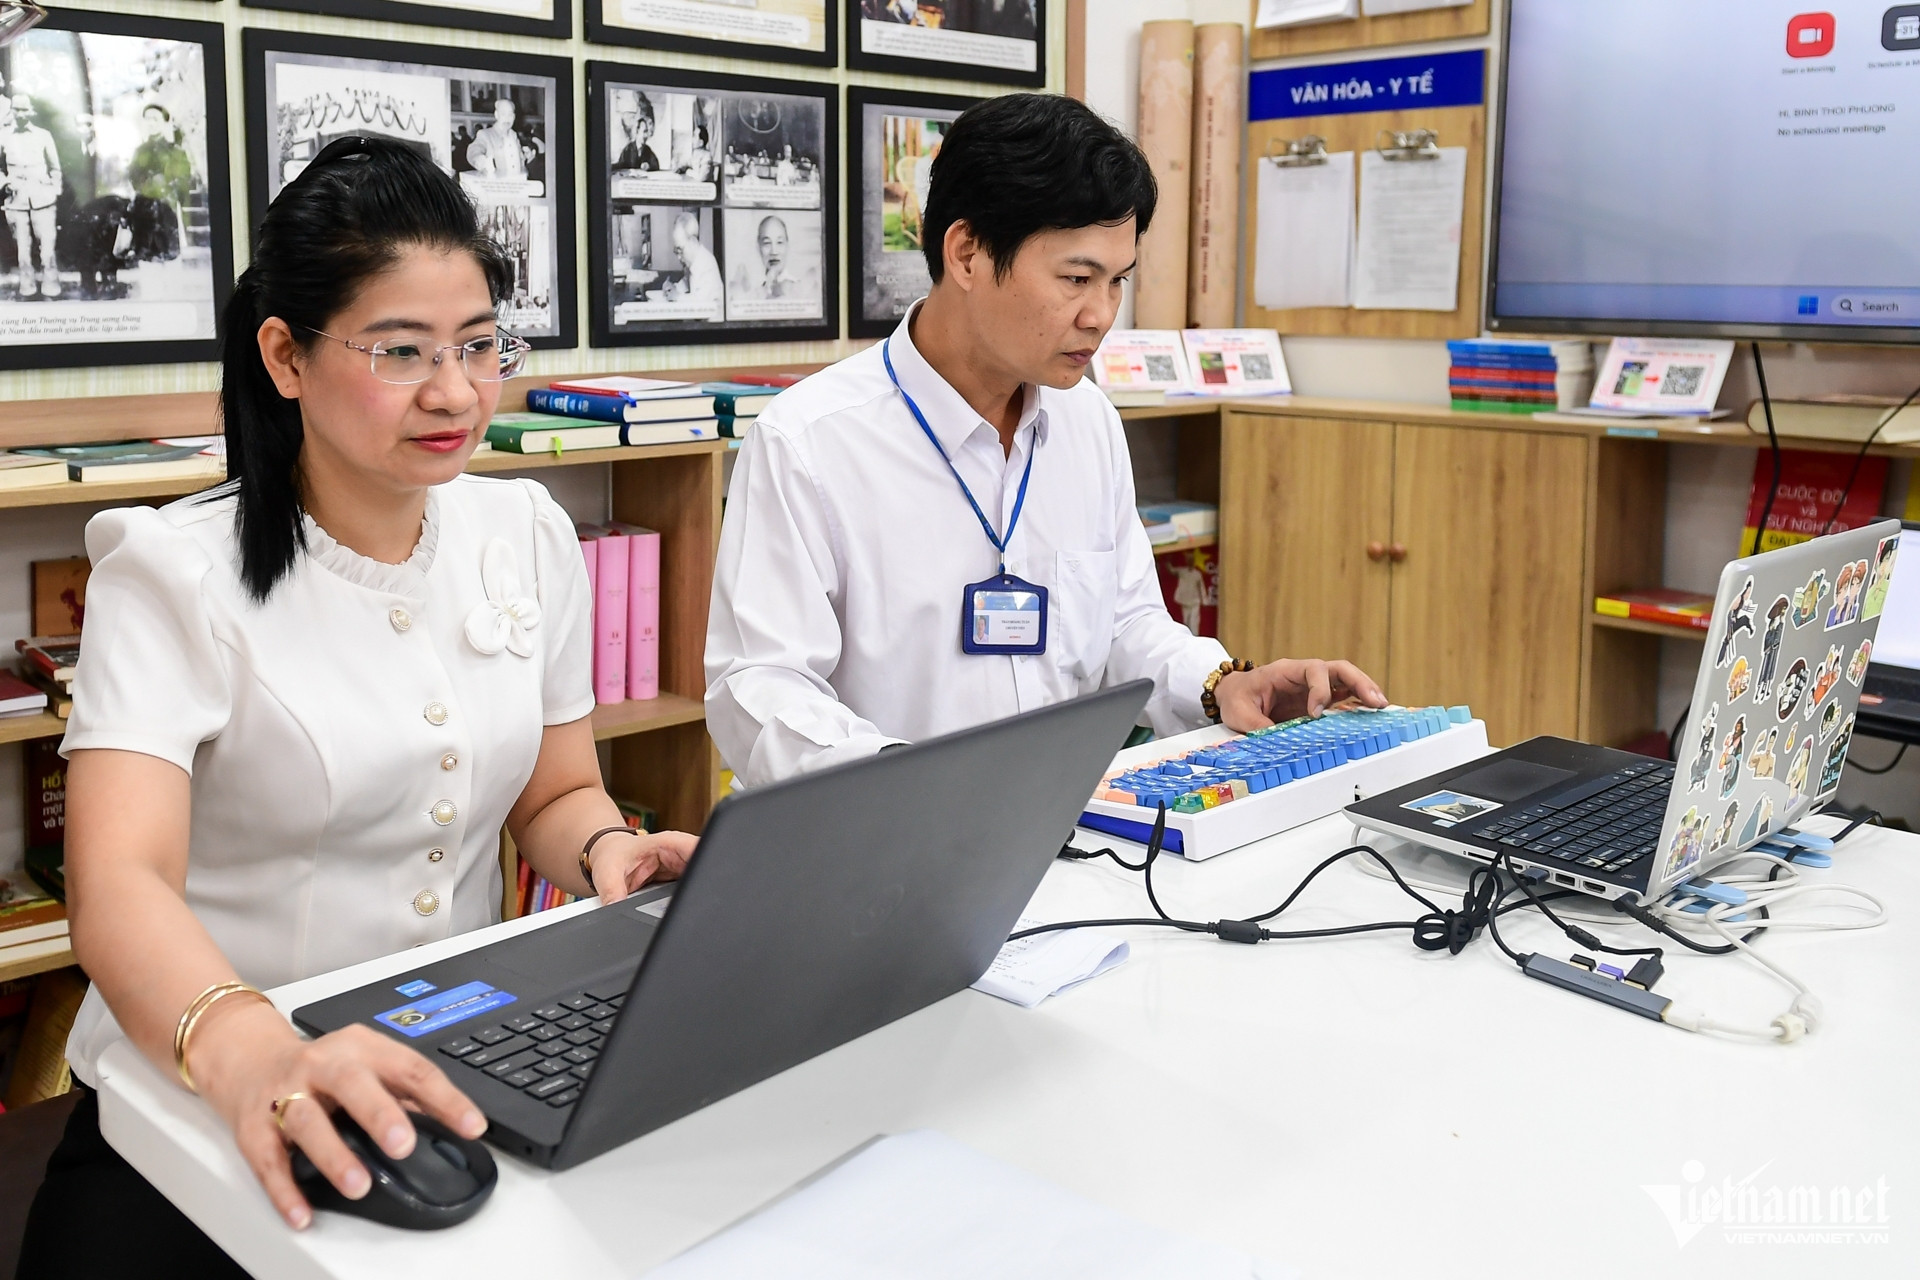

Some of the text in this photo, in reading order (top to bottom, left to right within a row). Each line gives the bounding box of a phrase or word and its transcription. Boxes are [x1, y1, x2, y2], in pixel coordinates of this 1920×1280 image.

[1291, 82, 1328, 104] VĂN
[1332, 77, 1373, 100] HÓA
[1389, 77, 1403, 96] Y
[1778, 124, 1886, 136] No scheduled meetings
[1862, 301, 1899, 313] Search
[1801, 502, 1818, 517] và
